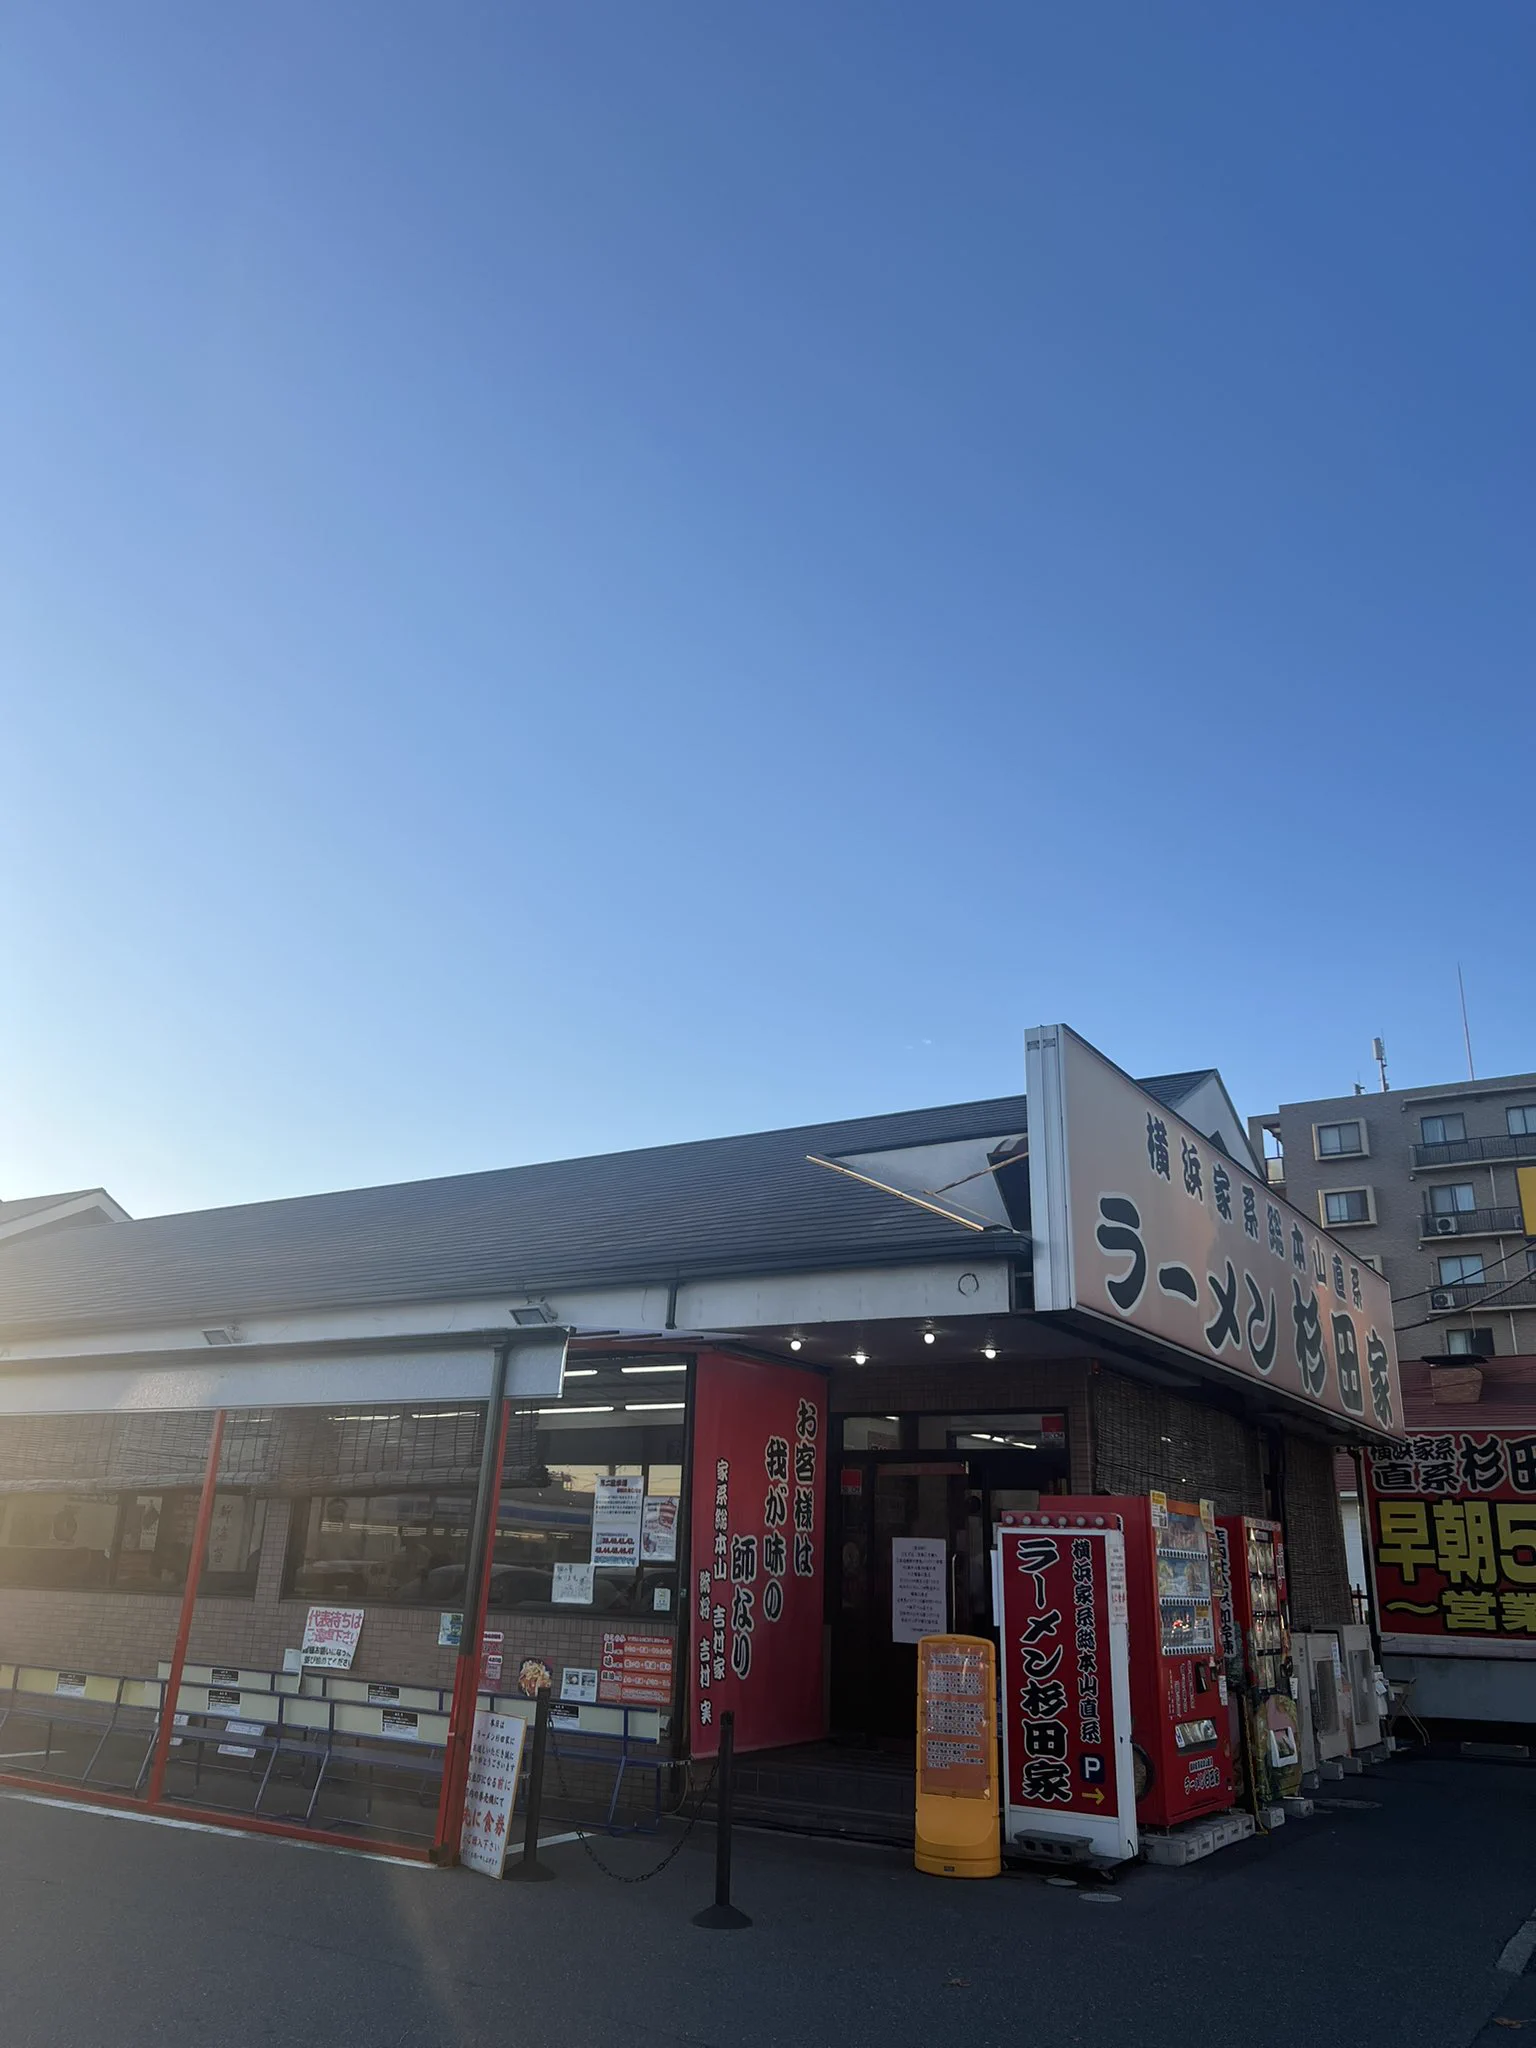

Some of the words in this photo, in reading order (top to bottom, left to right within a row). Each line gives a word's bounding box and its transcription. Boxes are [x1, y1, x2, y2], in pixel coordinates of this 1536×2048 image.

[1146, 1111, 1364, 1312] 横浜家系総本山直系
[1096, 1192, 1394, 1431] ラーメン杉田家
[713, 1457, 729, 1581] 家系総本山
[762, 1434, 789, 1623] 我が味の
[795, 1399, 818, 1578] お客様は
[1373, 1462, 1460, 1493] 直系
[700, 1637, 711, 1689] 吉村
[712, 1604, 726, 1680] 吉村家
[730, 1534, 757, 1680] 師なり
[1017, 1537, 1073, 1802] ラーメン杉田家
[1072, 1538, 1101, 1744] 横浜家系総本山直系
[1084, 1756, 1101, 1779] P
